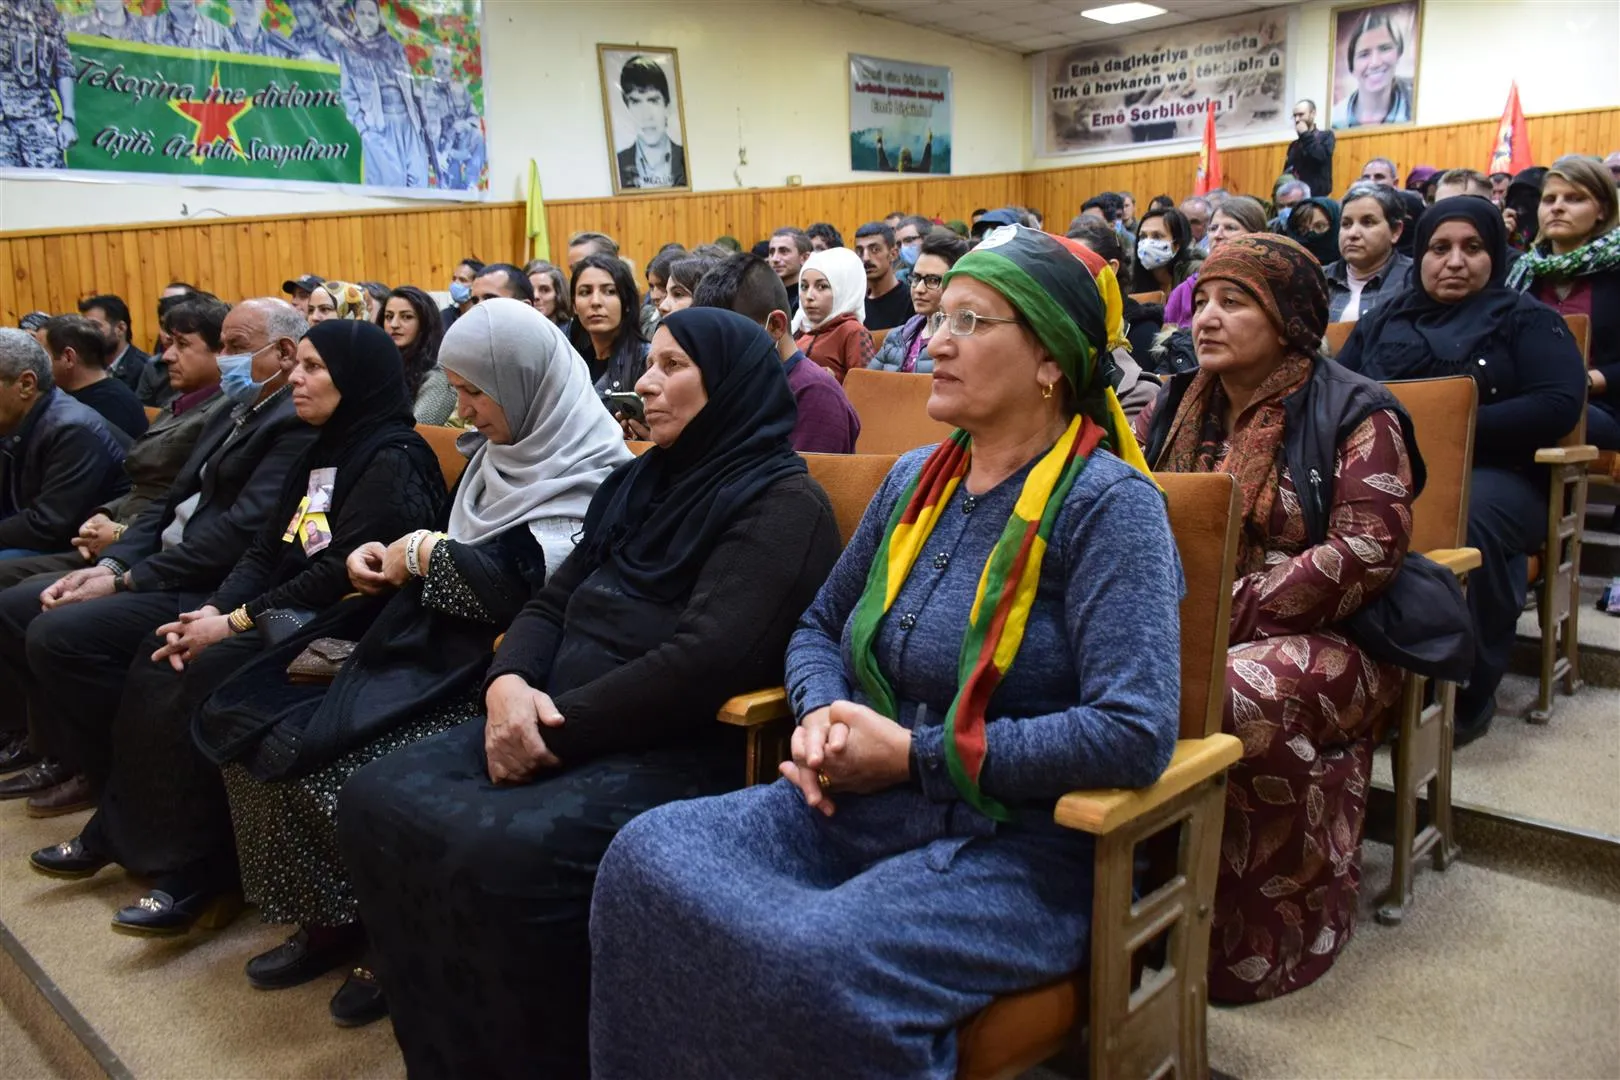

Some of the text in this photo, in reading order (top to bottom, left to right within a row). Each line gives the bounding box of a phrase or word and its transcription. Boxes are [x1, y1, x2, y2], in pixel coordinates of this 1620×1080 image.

[1071, 60, 1100, 78] Emê
[1193, 35, 1258, 57] dewleta
[204, 86, 246, 105] me
[1091, 107, 1125, 127] Emê
